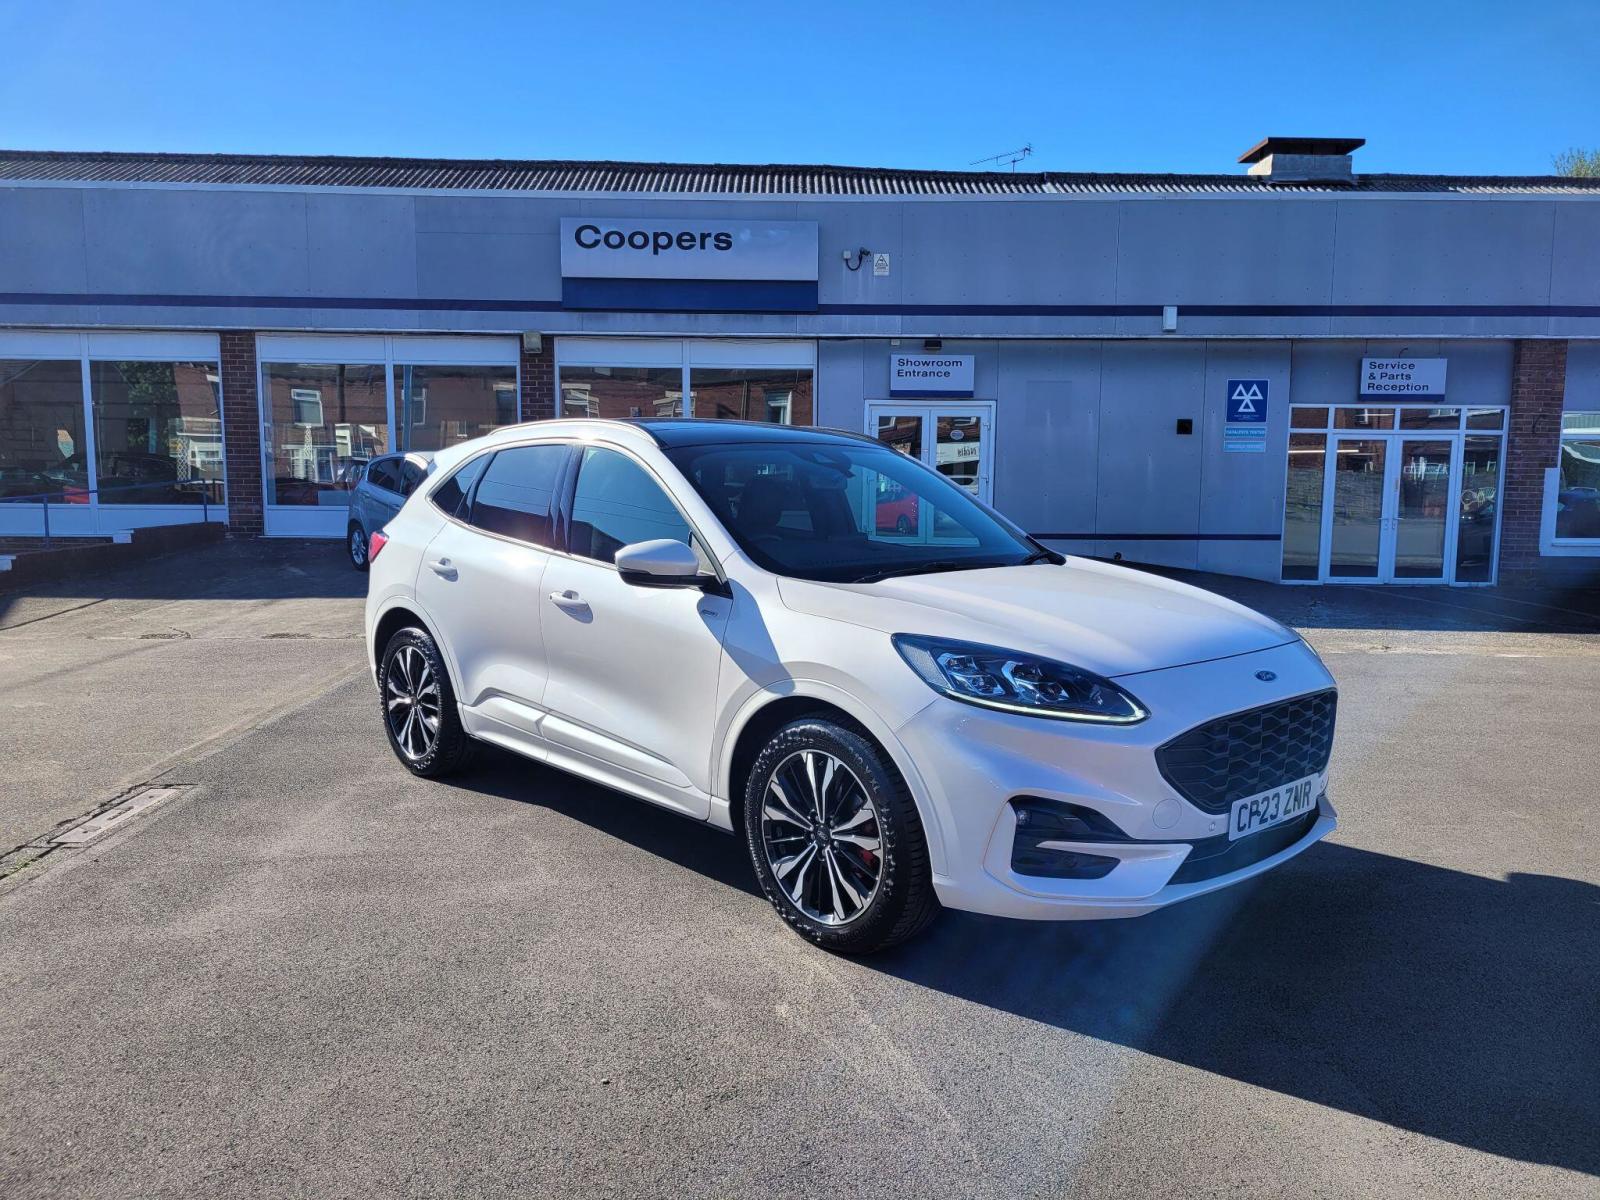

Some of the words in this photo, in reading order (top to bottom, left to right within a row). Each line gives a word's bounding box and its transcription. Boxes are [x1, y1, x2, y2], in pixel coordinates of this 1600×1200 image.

[574, 224, 733, 255] Coopers
[897, 358, 963, 367] Showroom
[1369, 361, 1415, 370] Service
[897, 369, 951, 378] Entrance
[1368, 372, 1376, 380] &
[1380, 372, 1412, 380] Parts
[1367, 382, 1429, 392] Reception
[1237, 792, 1281, 832] CP23
[1283, 780, 1312, 815] ZNR
